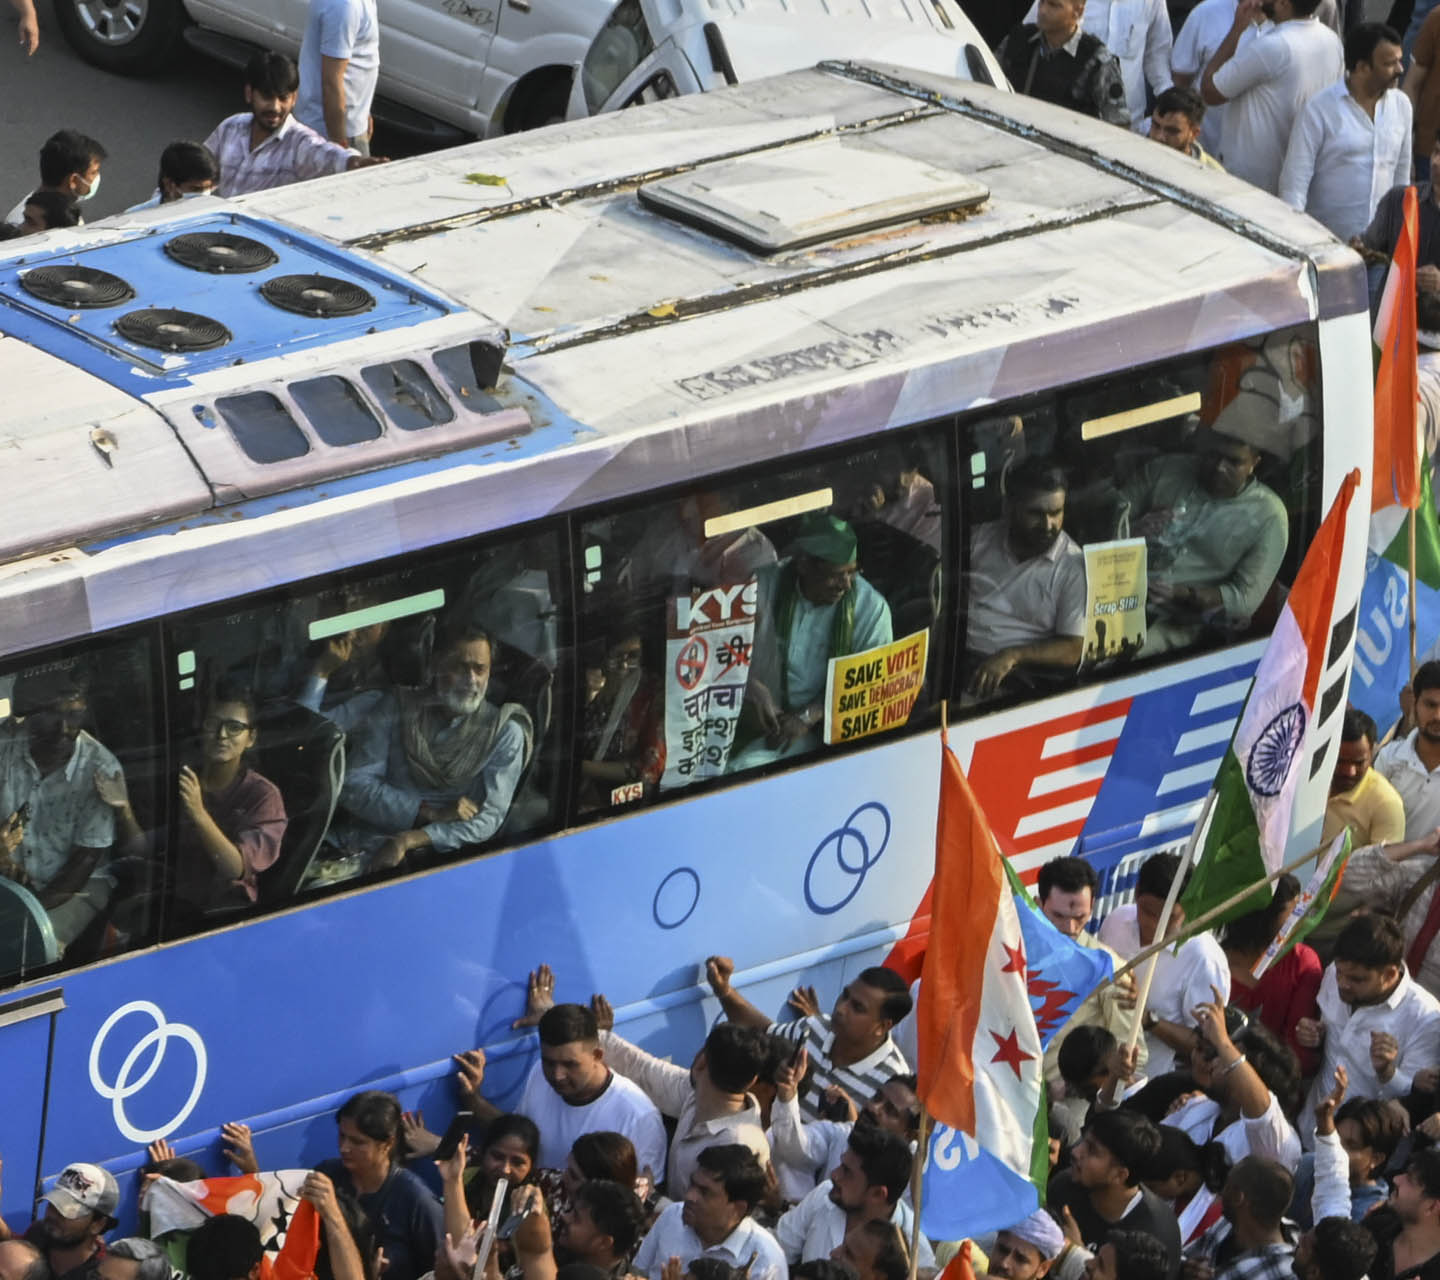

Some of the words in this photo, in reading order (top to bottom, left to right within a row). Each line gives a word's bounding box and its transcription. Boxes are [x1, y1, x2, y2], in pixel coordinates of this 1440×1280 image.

[844, 657, 883, 690] SAVE
[886, 642, 920, 675] VOTE
[838, 689, 866, 713] SAVE
[841, 708, 879, 740] SAVE
[613, 784, 642, 805] KYS
